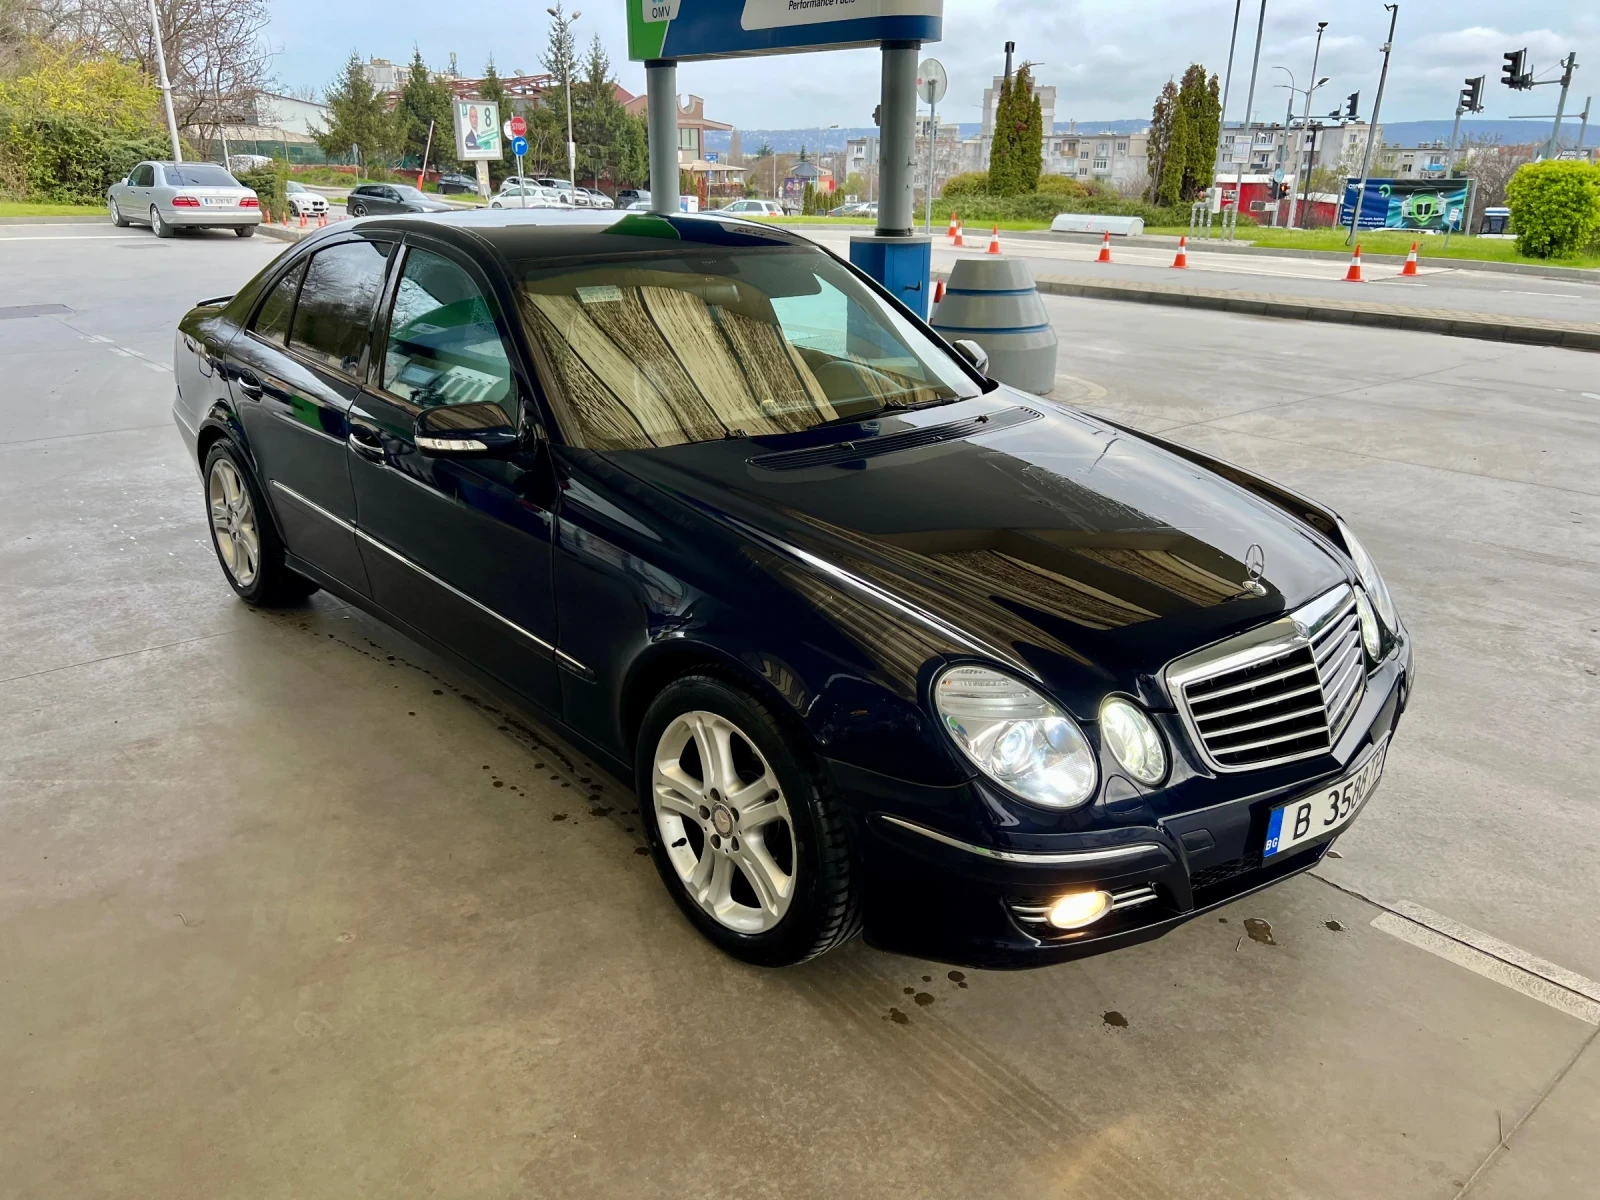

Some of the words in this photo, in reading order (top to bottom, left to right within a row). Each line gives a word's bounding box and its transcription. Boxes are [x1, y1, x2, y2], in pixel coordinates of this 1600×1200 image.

[788, 0, 833, 10] Performance
[652, 6, 671, 19] OMV
[484, 107, 491, 128] 8
[511, 122, 525, 131] STOP
[1292, 802, 1312, 841] B
[1323, 766, 1369, 826] 3588
[1265, 837, 1279, 851] BG
